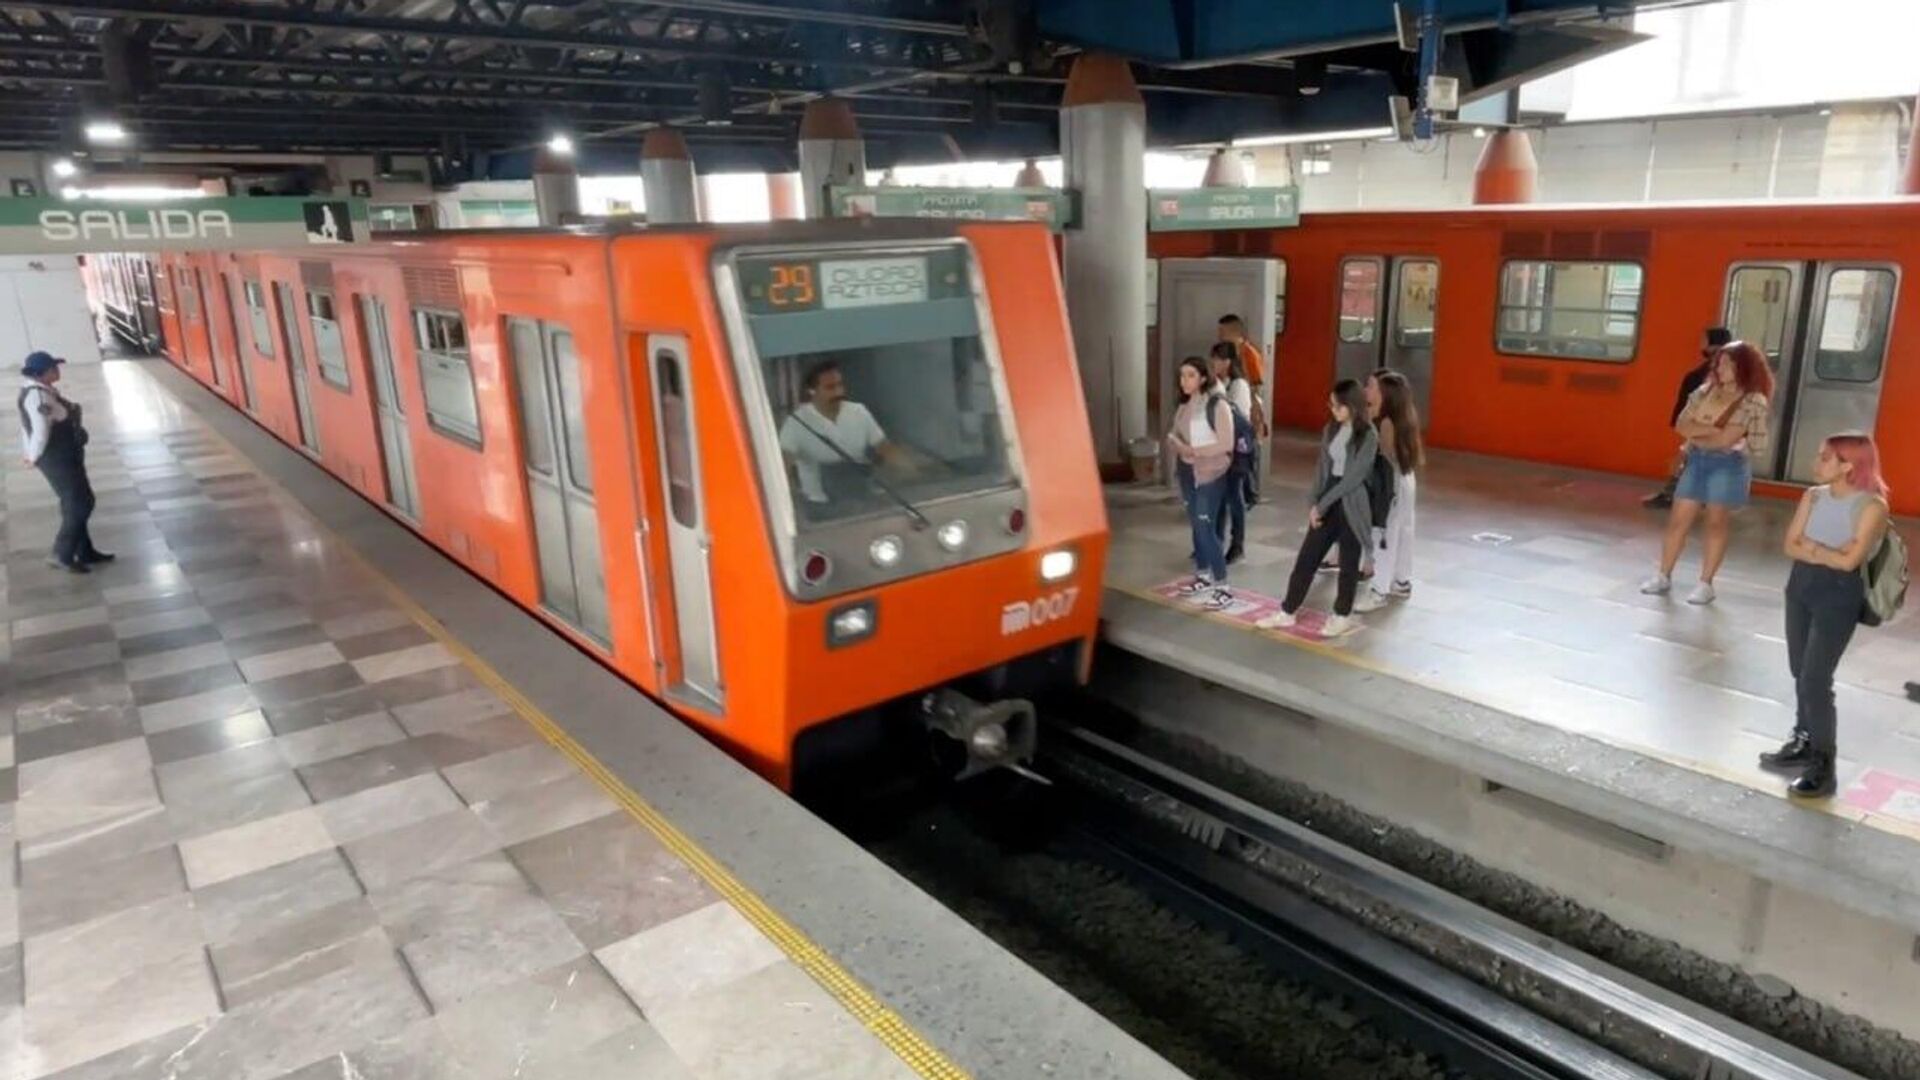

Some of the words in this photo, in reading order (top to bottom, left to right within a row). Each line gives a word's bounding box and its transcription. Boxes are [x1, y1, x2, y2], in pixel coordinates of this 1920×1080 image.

[39, 210, 233, 241] SALIDA
[769, 264, 815, 305] 29
[828, 280, 925, 298] AZTECA
